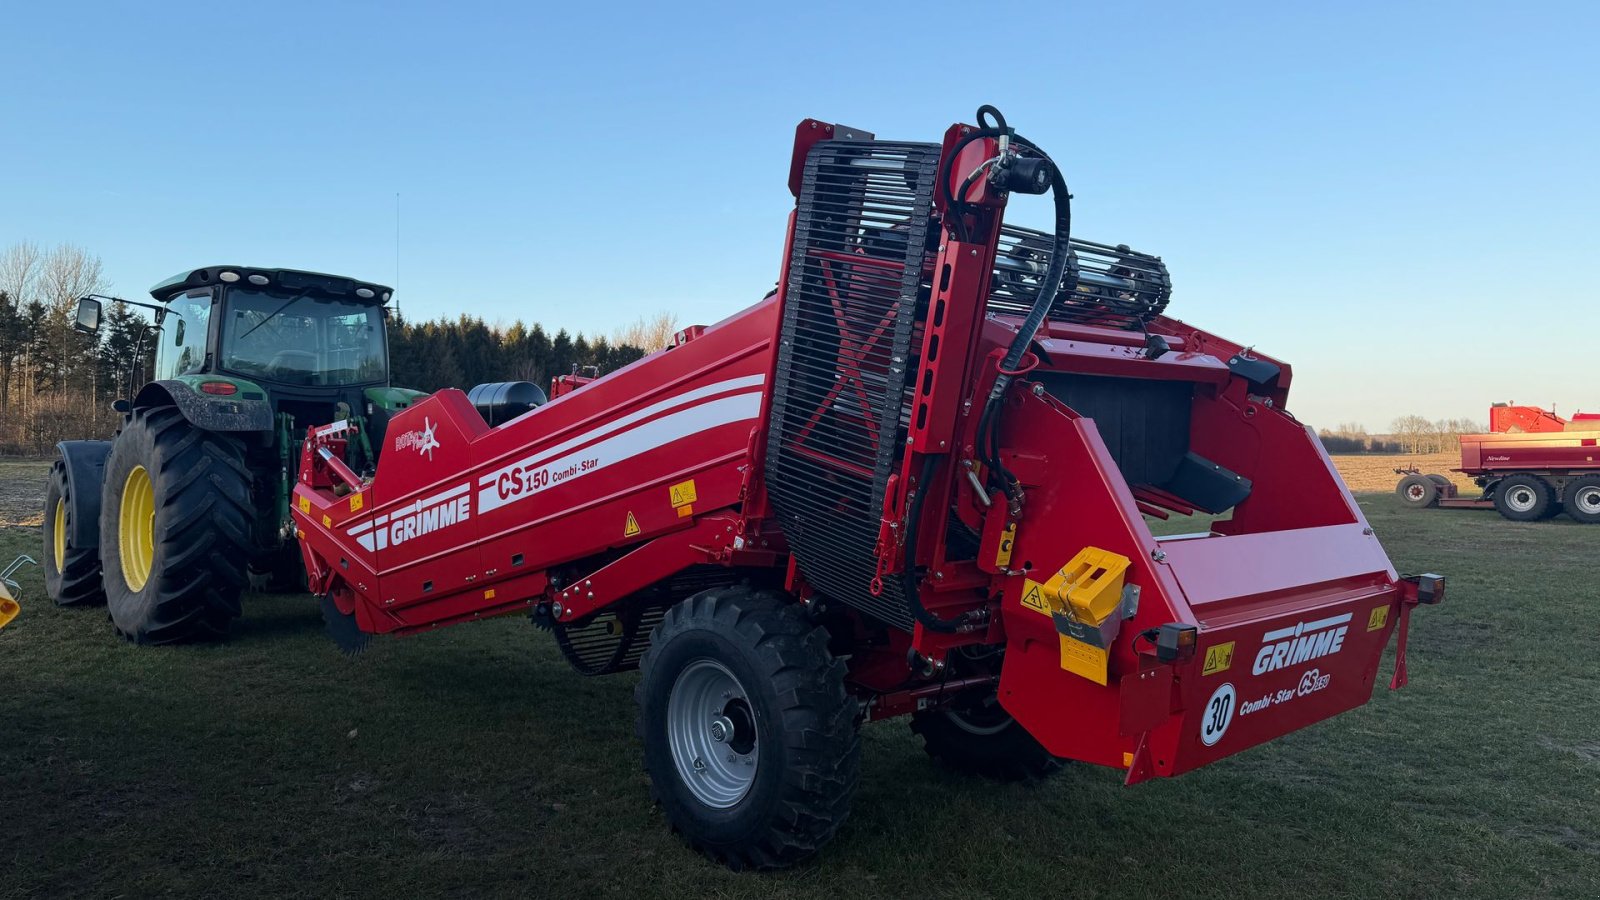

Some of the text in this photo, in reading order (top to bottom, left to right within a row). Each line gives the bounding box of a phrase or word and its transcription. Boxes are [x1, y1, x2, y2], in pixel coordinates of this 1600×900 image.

[391, 494, 470, 546] GRIMME
[1252, 622, 1348, 676] GRIMME
[1206, 693, 1231, 735] 30
